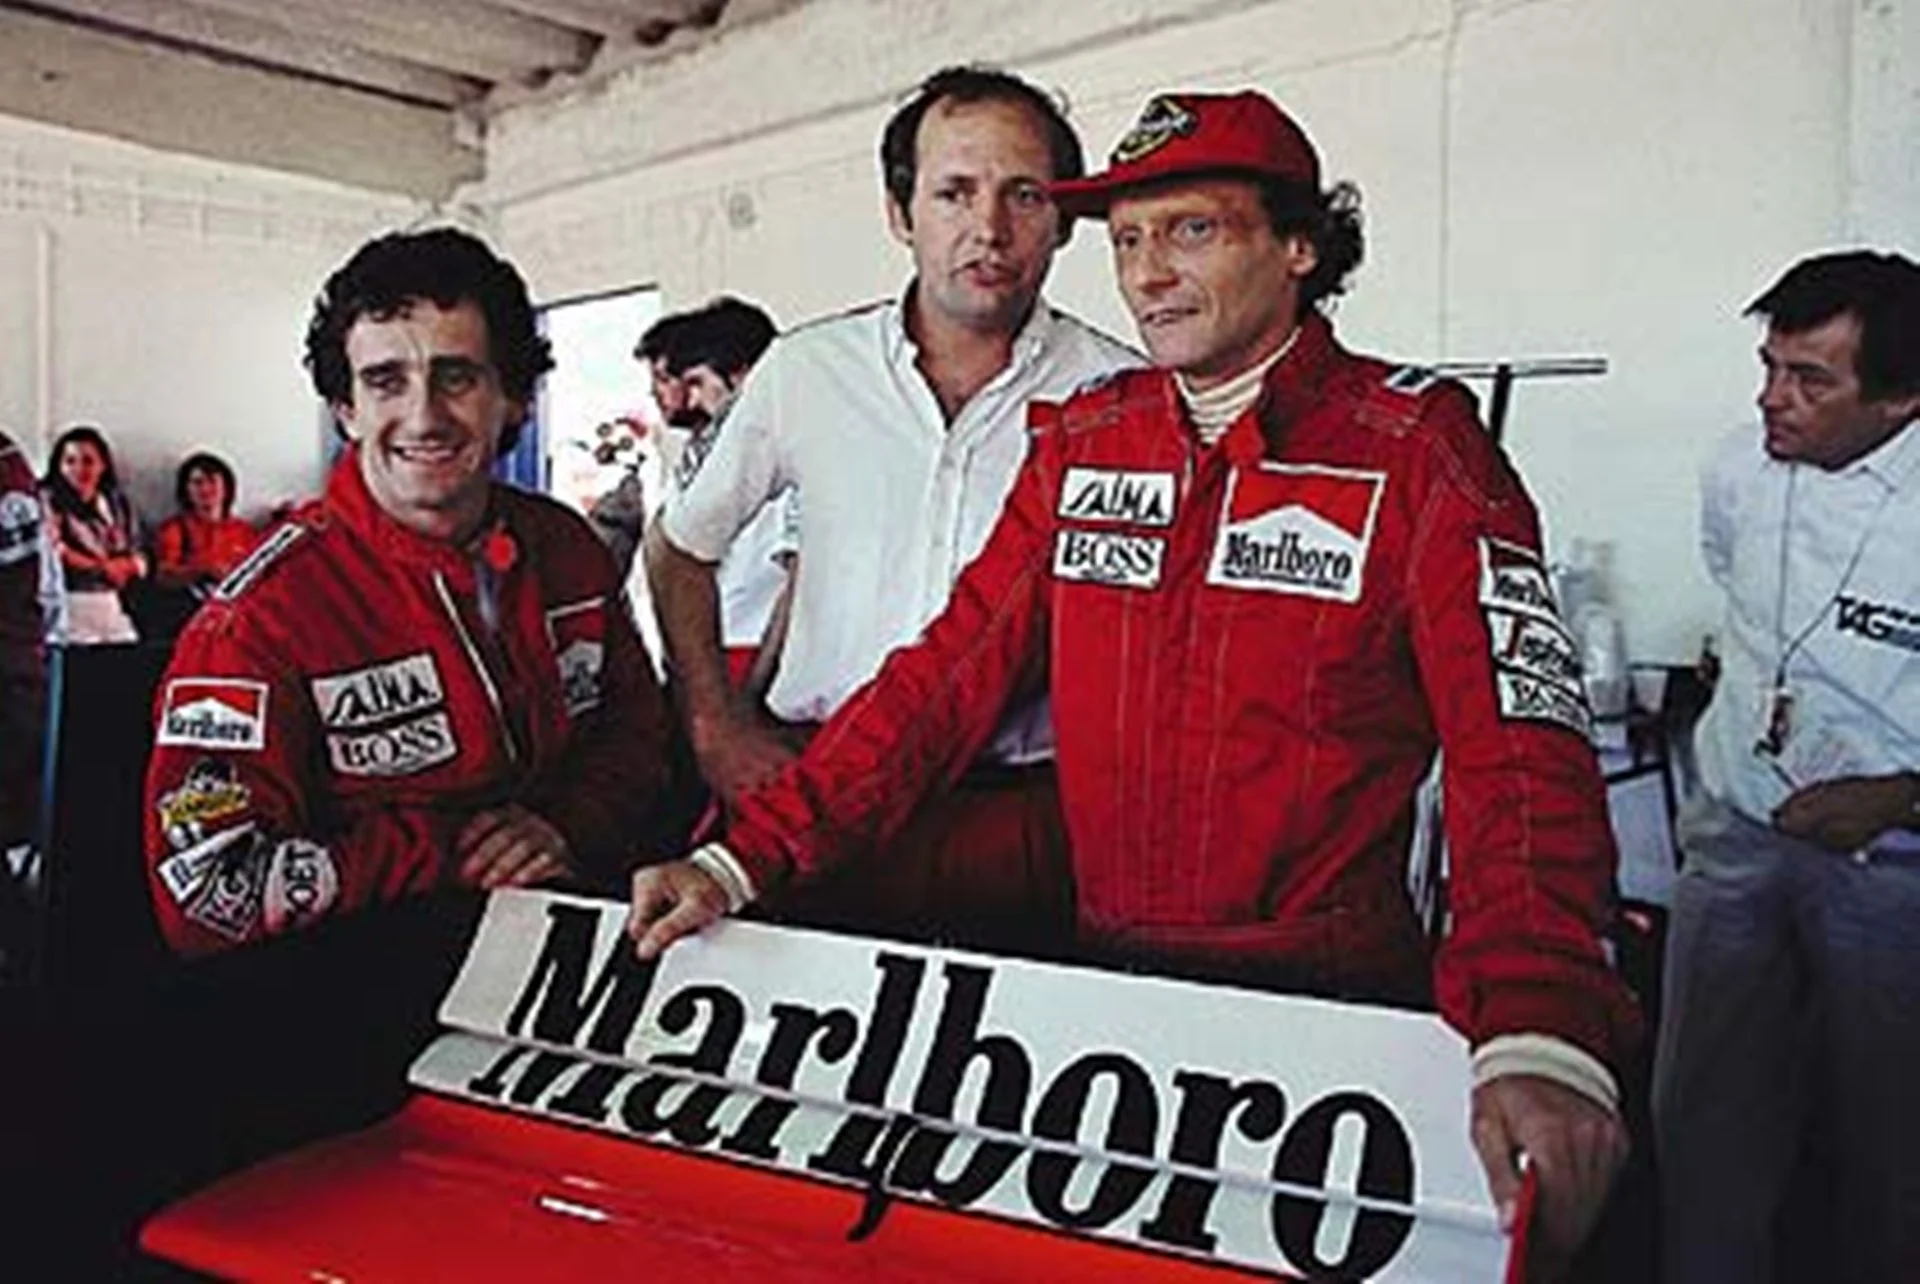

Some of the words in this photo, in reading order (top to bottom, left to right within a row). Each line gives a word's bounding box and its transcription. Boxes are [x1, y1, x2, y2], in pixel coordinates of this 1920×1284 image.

[1063, 532, 1156, 575] BOSS
[1223, 531, 1353, 580] Marlboro
[1834, 595, 1896, 641] TAG
[337, 720, 445, 767] BOSS
[469, 902, 1416, 1284] Marlboro
